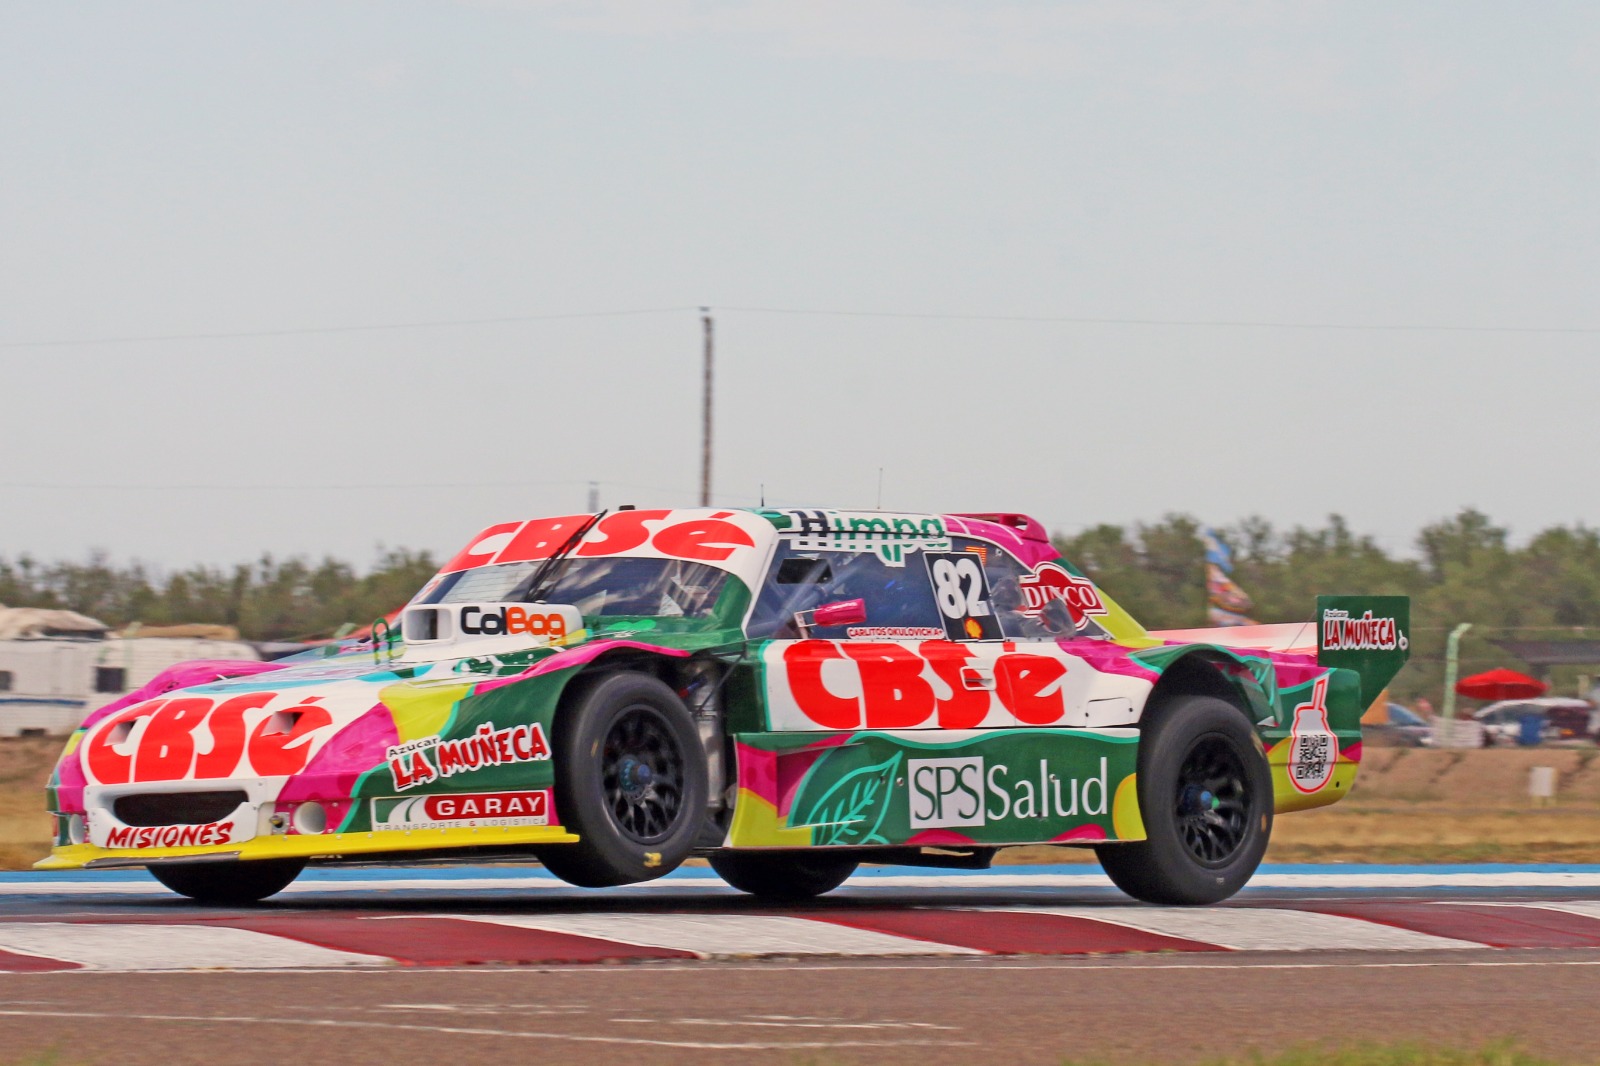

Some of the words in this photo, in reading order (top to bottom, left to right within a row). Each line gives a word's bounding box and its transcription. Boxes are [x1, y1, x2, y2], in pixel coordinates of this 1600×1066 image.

[789, 510, 950, 563] Himpa
[932, 558, 990, 619] 82
[1021, 585, 1097, 608] DINCO
[461, 606, 566, 645] ColBag
[849, 628, 886, 636] CARLITOS
[1324, 620, 1340, 647] LA
[1344, 614, 1395, 647] MUÑECA
[392, 752, 434, 789] LA
[439, 726, 547, 775] MUÑECA
[914, 764, 979, 820] SPS
[987, 756, 1108, 820] Salud
[436, 797, 541, 816] GARAY
[106, 822, 234, 848] MISIONES
[376, 820, 461, 830] TRANSPORTE
